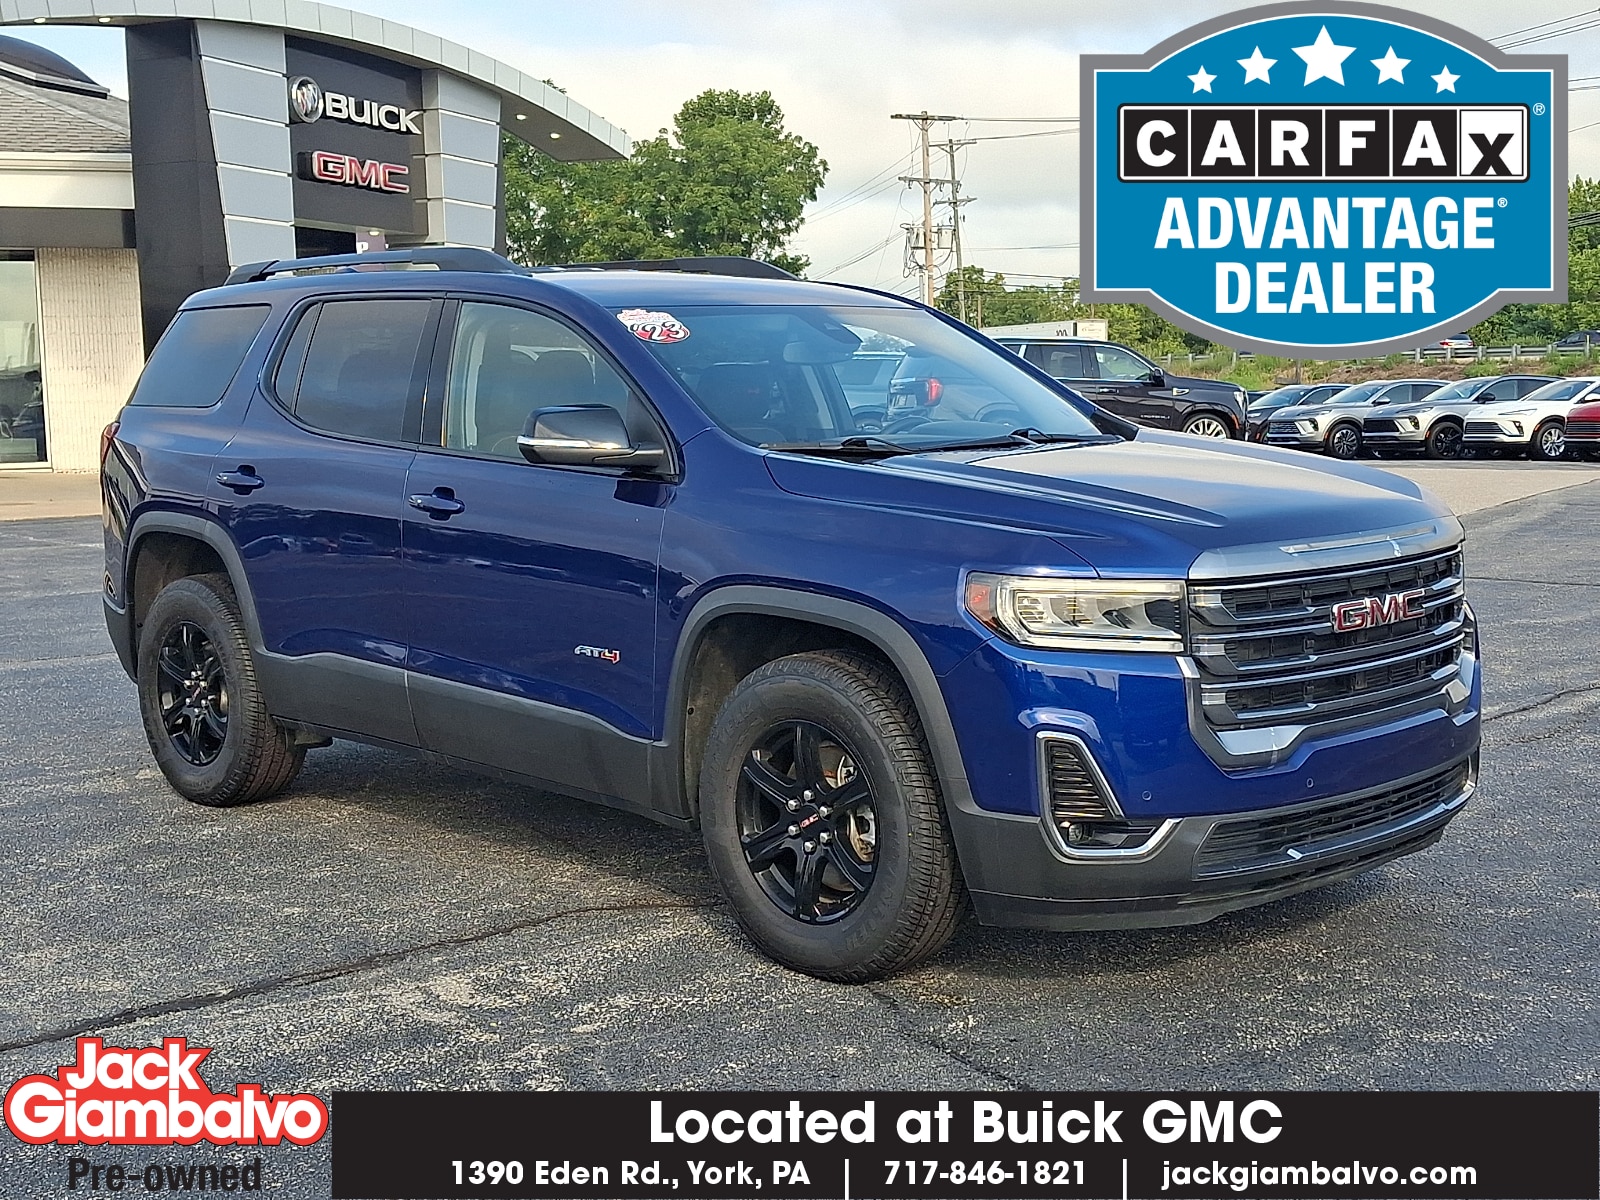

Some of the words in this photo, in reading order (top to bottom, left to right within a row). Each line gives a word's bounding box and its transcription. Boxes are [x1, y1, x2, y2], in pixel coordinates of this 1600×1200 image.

[324, 91, 422, 134] BUICK
[312, 150, 410, 194] GMC
[1331, 588, 1426, 633] GMC
[574, 645, 620, 664] AT4
